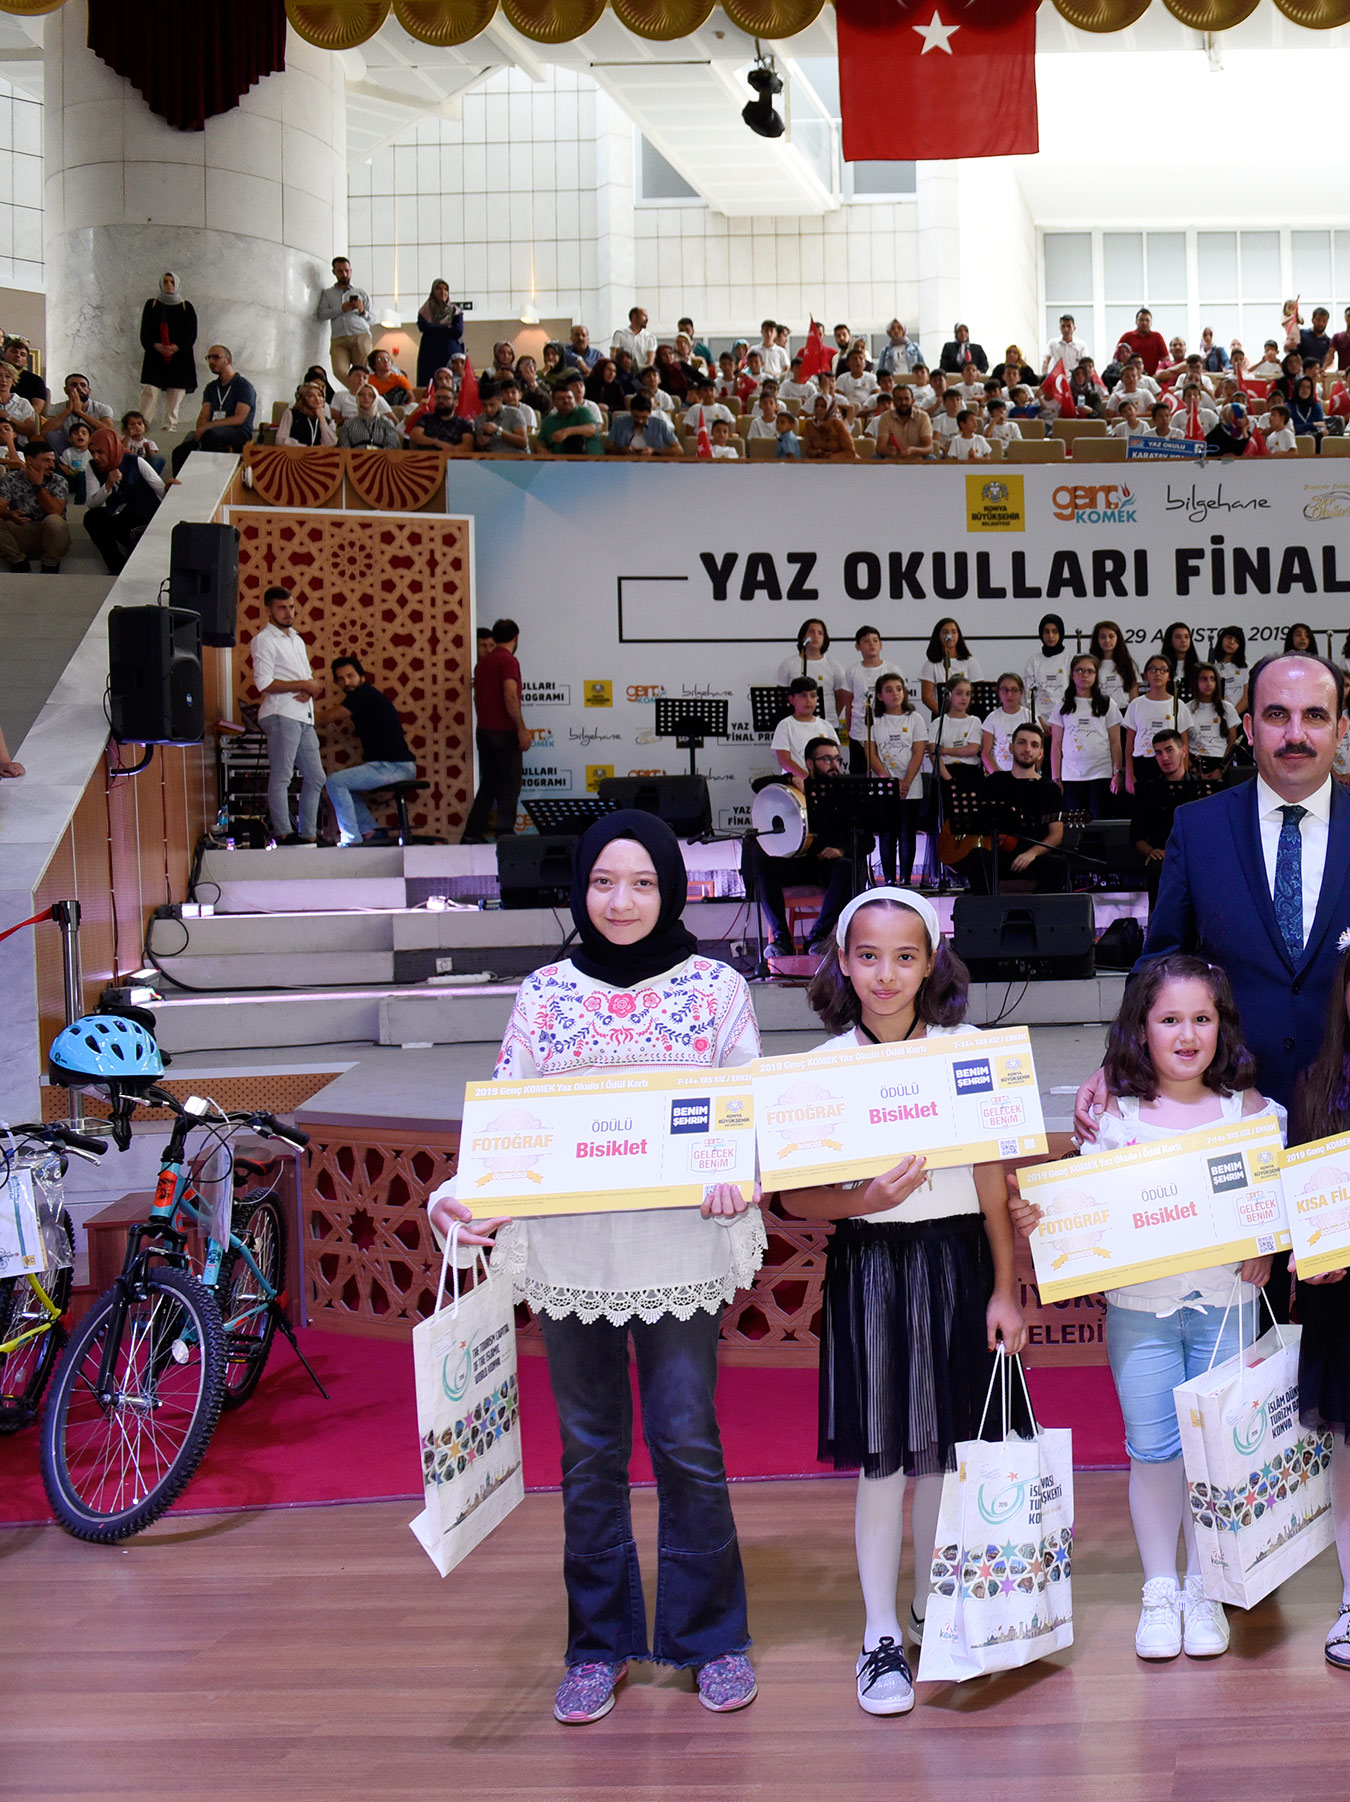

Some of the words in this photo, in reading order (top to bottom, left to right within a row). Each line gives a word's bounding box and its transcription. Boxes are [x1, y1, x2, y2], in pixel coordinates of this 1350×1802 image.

[1165, 484, 1272, 523] bilgehane
[1075, 510, 1137, 524] KOMEK
[700, 551, 819, 601] YAZ
[844, 548, 1149, 600] OKULLARI
[1125, 629, 1147, 644] 29
[1248, 626, 1291, 642] 2019
[569, 727, 623, 746] bilgehane
[760, 1062, 782, 1072] 2019
[783, 1059, 805, 1071] Genç
[807, 1055, 837, 1066] KOMEK
[838, 1053, 853, 1062] Yaz
[475, 1087, 497, 1096] 2019
[499, 1086, 522, 1096] Genç
[523, 1084, 555, 1093] KOMEK
[556, 1083, 571, 1091] Yaz
[879, 1081, 919, 1098] ÖDÜLÜ
[766, 1099, 845, 1125] FOTOĞRAF
[868, 1100, 938, 1124] Bisiklet
[983, 1104, 1021, 1117] GELECEK
[591, 1117, 632, 1132] ÖDÜLÜ
[471, 1130, 553, 1151] FOTOĞRAF
[575, 1138, 647, 1158] Bisiklet
[693, 1148, 733, 1159] GELECEK
[1286, 1150, 1305, 1162] 2019
[1306, 1144, 1325, 1158] Genç
[1140, 1181, 1178, 1202] ÖDÜLÜ
[1239, 1199, 1276, 1215] GELECEK
[1296, 1193, 1327, 1214] KISA
[1037, 1205, 1111, 1236] FOTOĞRAF
[1132, 1200, 1197, 1229] Bisiklet
[1029, 1318, 1104, 1345] ELEDİ
